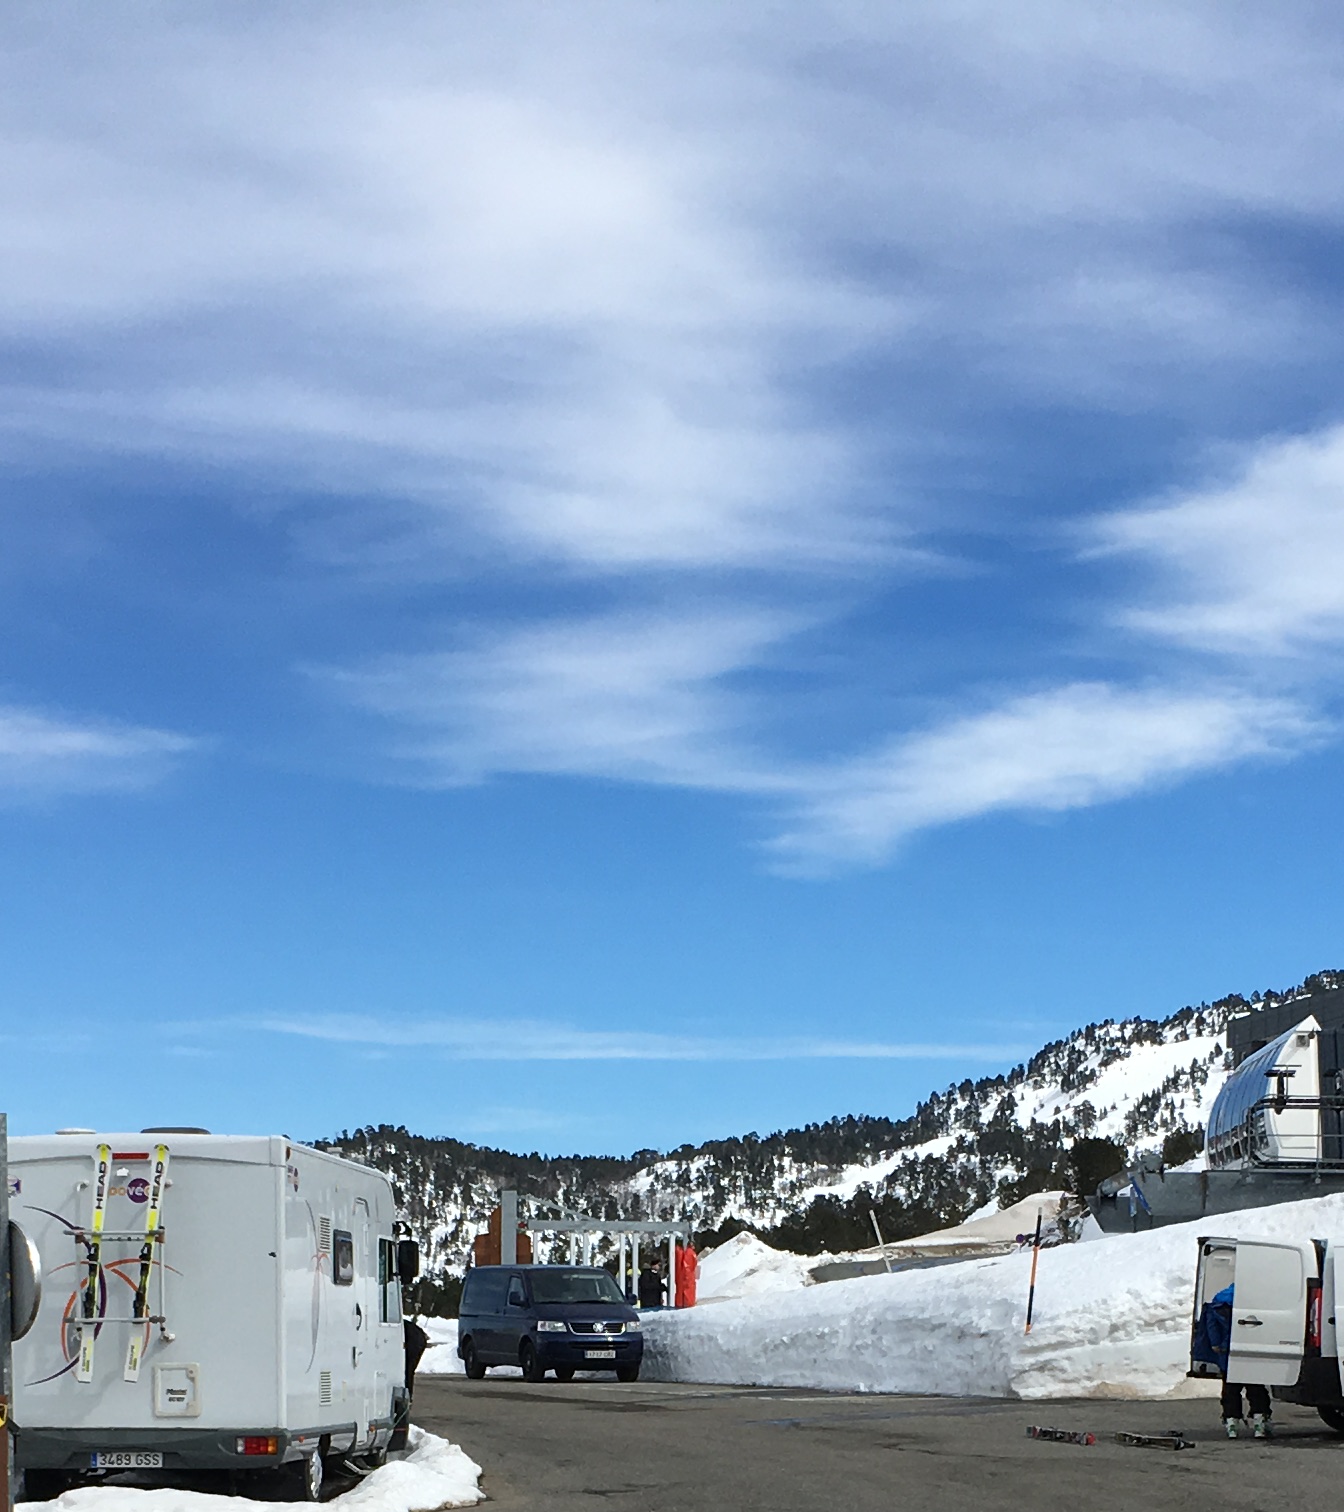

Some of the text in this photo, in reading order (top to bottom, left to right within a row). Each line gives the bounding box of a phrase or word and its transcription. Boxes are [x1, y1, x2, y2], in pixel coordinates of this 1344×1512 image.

[95, 1161, 107, 1209] HEAD
[109, 1183, 151, 1197] oovéo
[150, 1161, 164, 1209] HEAD
[99, 1453, 160, 1466] 3489 GSS
